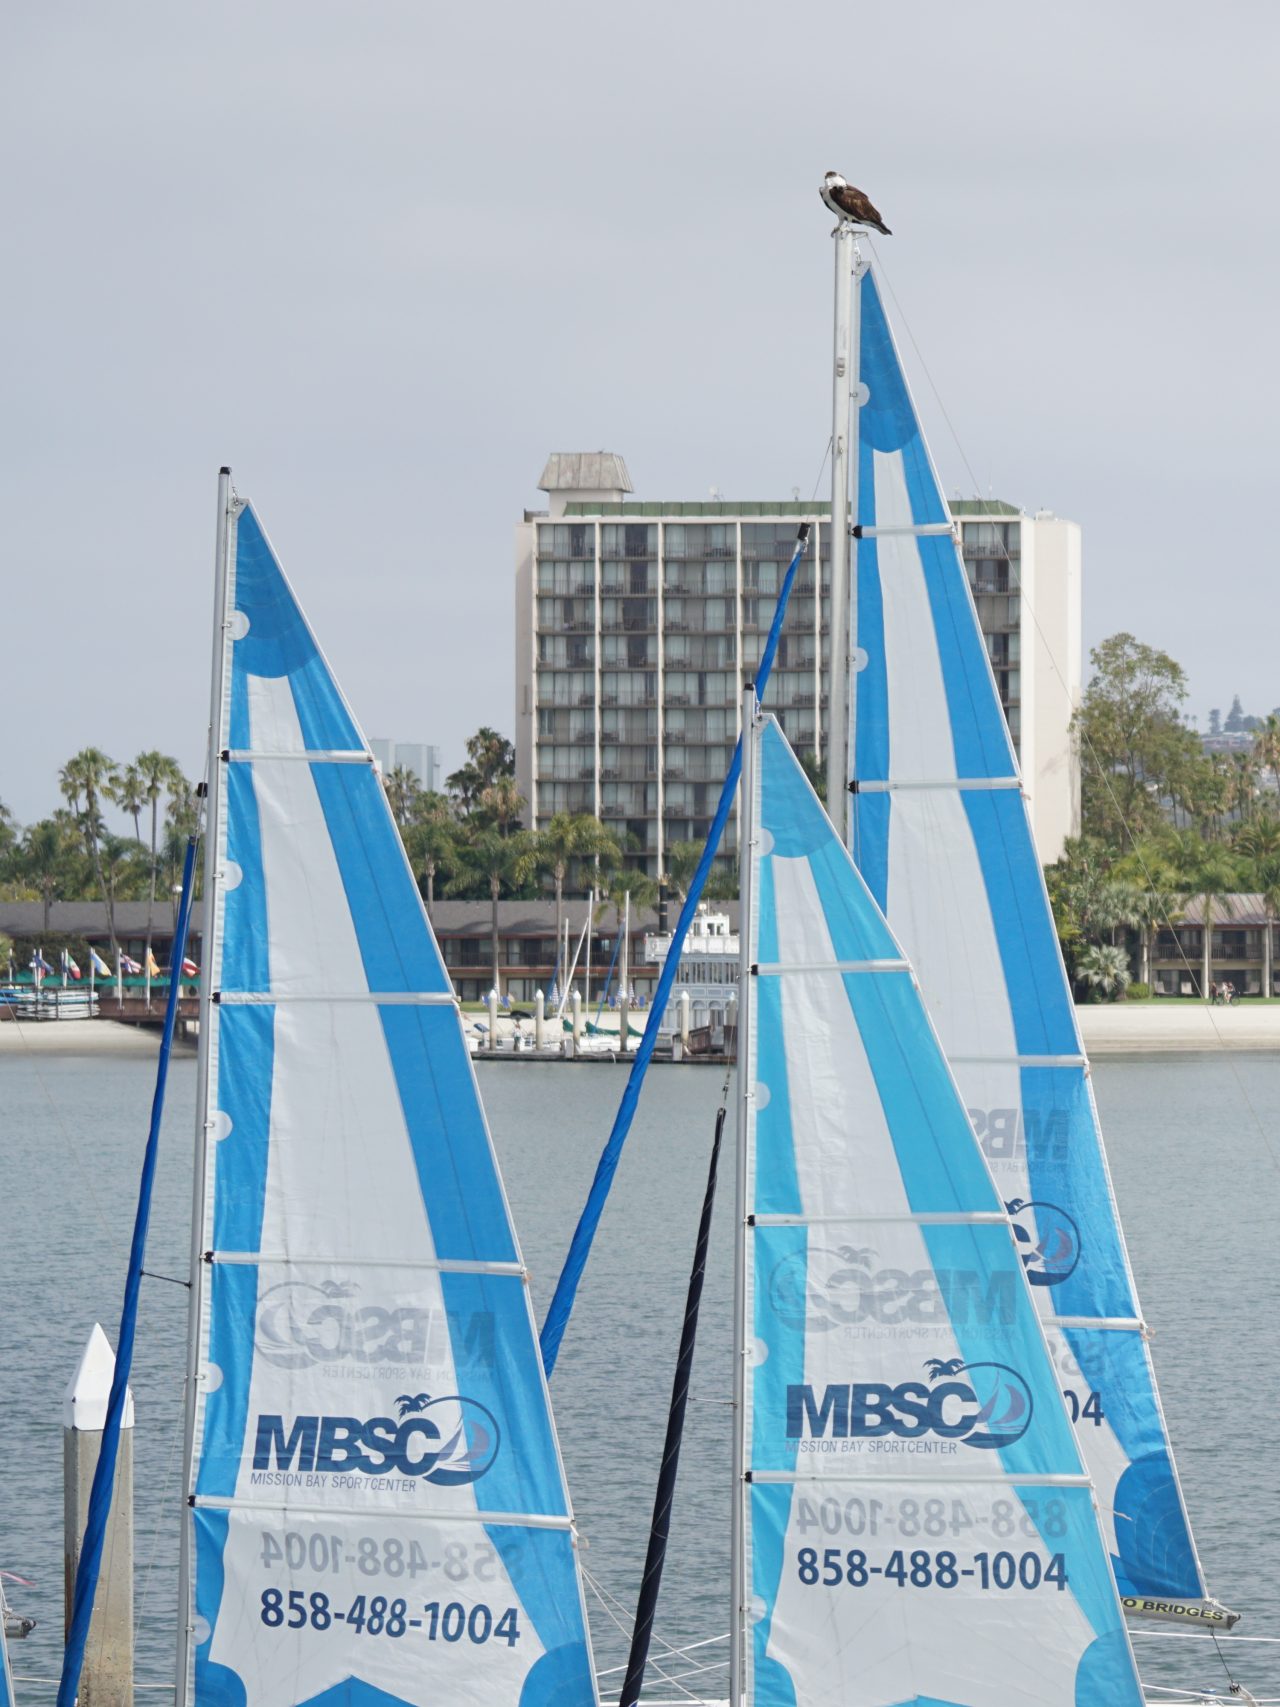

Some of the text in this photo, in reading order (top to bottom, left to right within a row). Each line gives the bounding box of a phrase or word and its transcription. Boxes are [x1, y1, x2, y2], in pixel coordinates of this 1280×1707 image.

[786, 1382, 978, 1439] MBSC
[252, 1415, 441, 1477] MBSC
[785, 1440, 957, 1455] MISSION BAY SPORTCENTER
[250, 1472, 417, 1492] MISSION BAY SPORTCENTER
[797, 1548, 1069, 1591] 858-488-1004
[260, 1588, 521, 1647] 858-488-1004
[1142, 1601, 1224, 1621] BRIDGES
